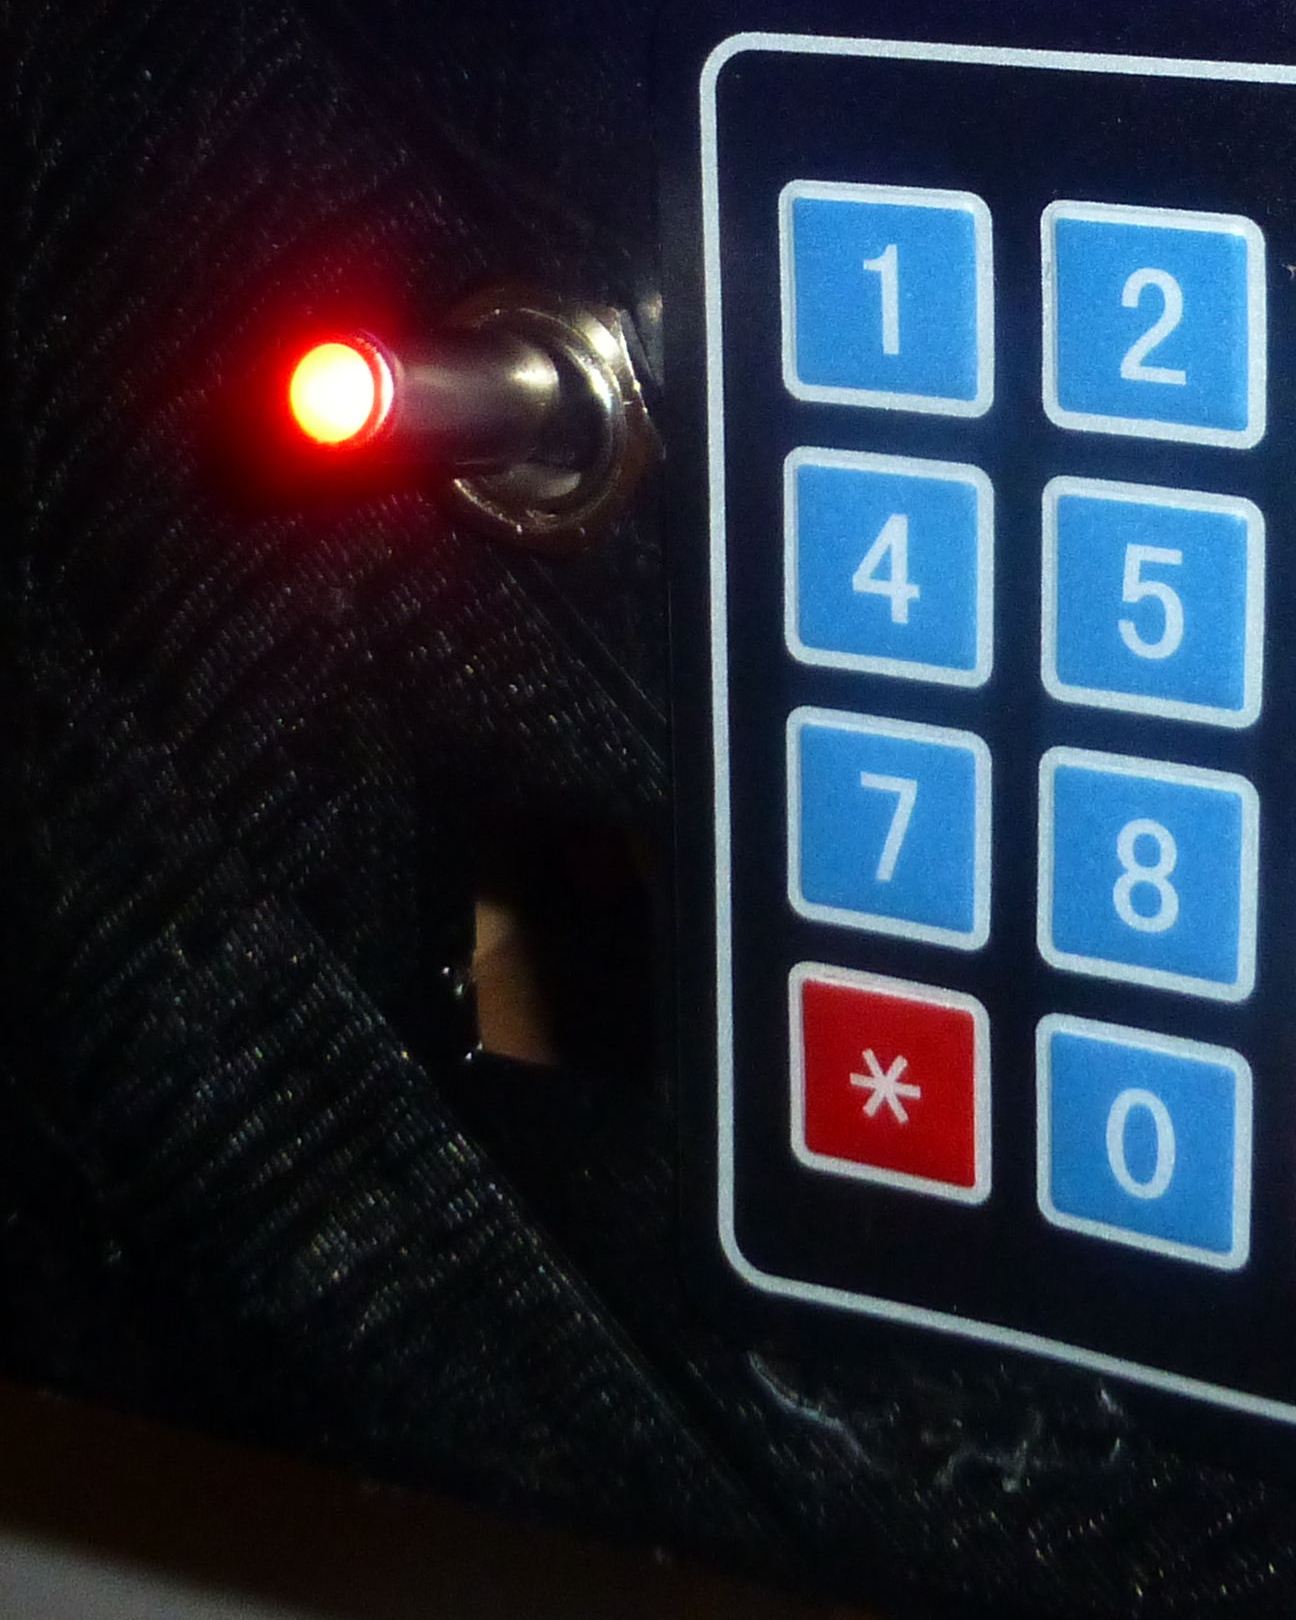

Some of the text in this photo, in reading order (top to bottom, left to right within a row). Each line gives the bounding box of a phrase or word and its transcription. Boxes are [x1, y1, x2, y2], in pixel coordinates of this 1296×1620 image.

[863, 244, 900, 355] 1
[1120, 267, 1187, 386] 2
[852, 513, 920, 624] 4
[1118, 543, 1185, 660] 5
[860, 771, 918, 881] 7
[1111, 818, 1179, 934] 8
[1104, 1086, 1176, 1201] 0
